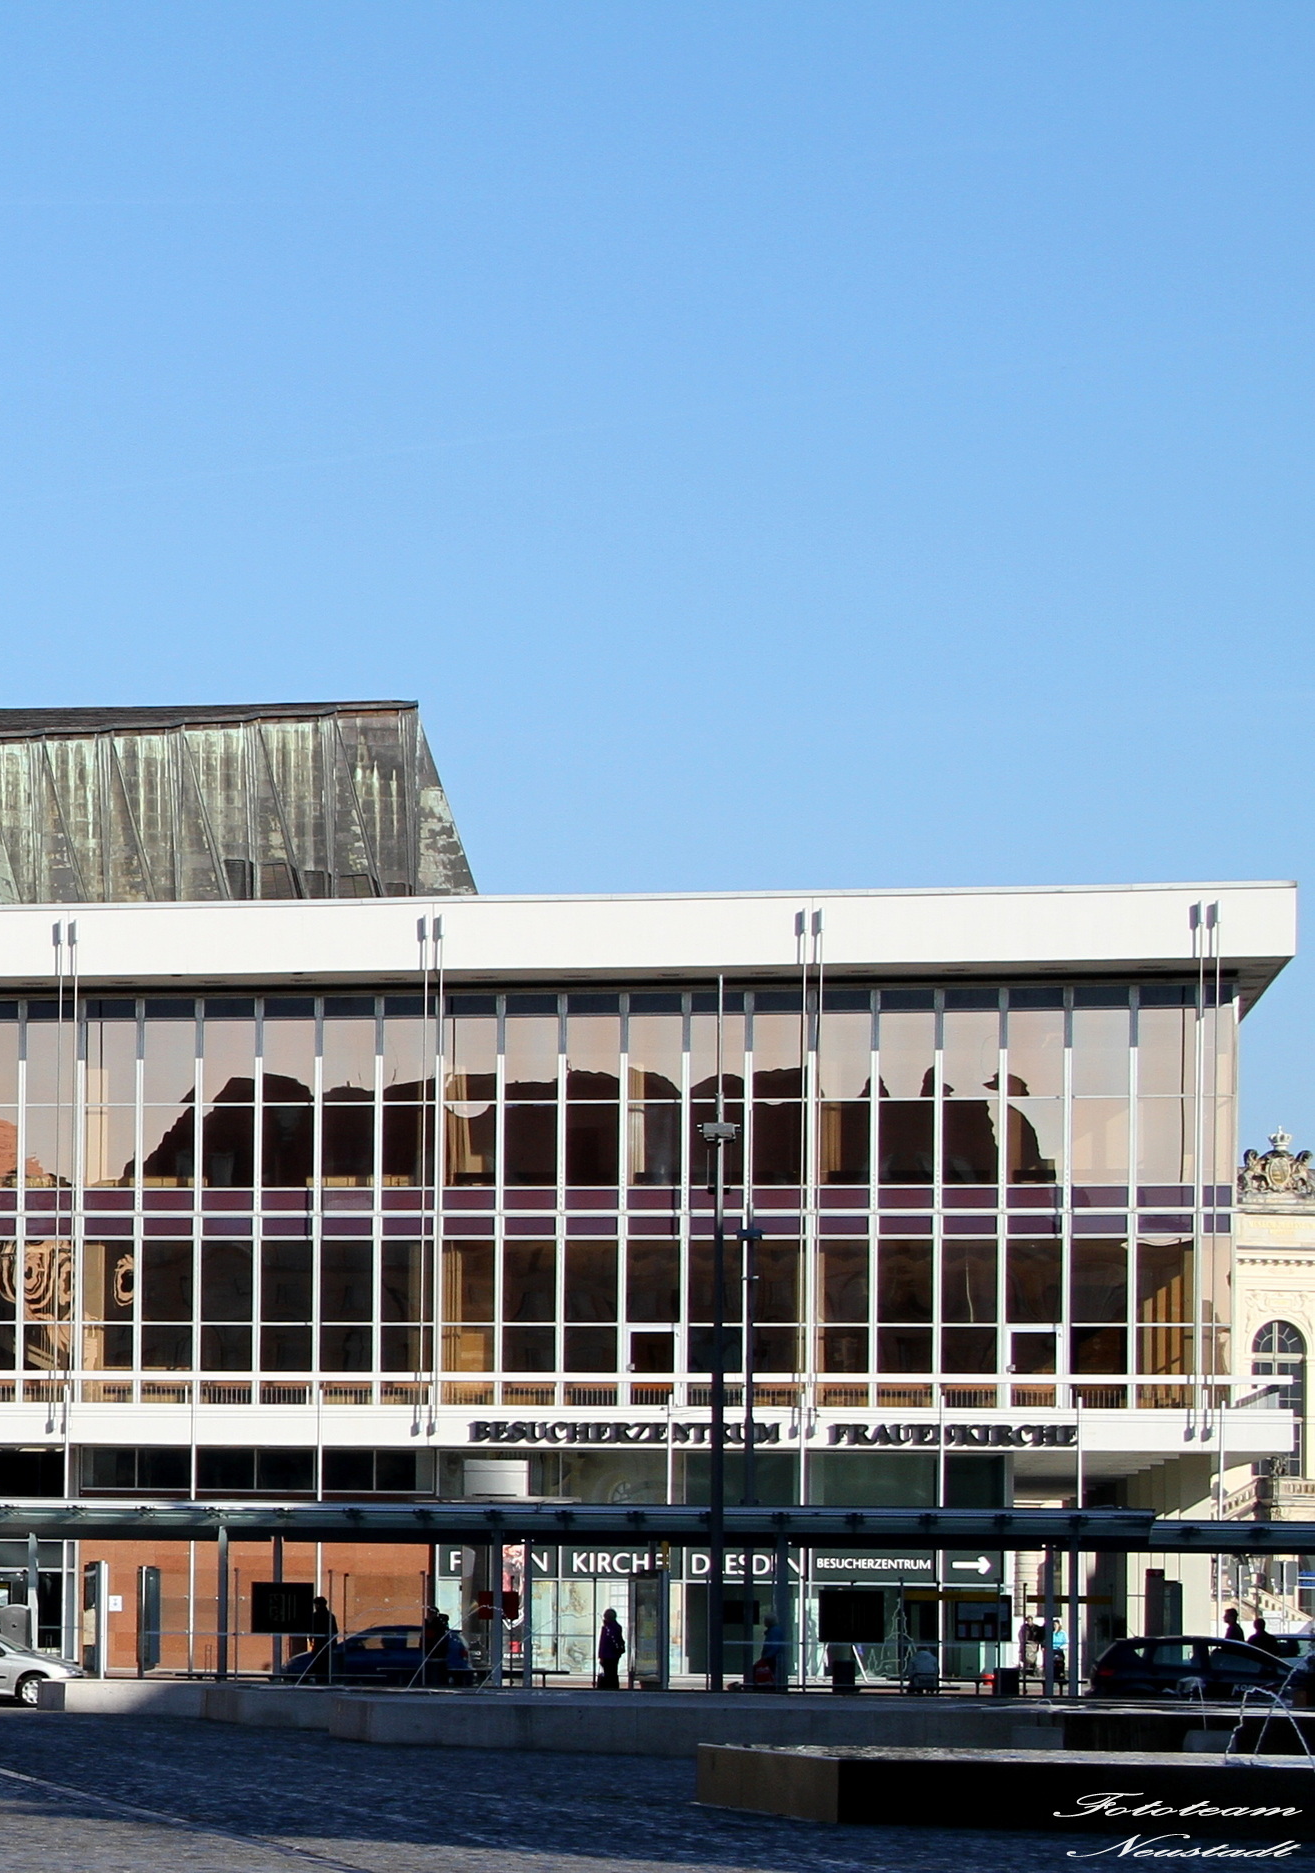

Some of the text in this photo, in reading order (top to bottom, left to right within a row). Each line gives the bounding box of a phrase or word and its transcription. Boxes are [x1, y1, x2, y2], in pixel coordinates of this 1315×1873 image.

[826, 1423, 1079, 1447] FRAUENKIRCHE
[691, 1553, 803, 1575] DESD
[816, 1557, 932, 1570] BESUCHERZENTRUM
